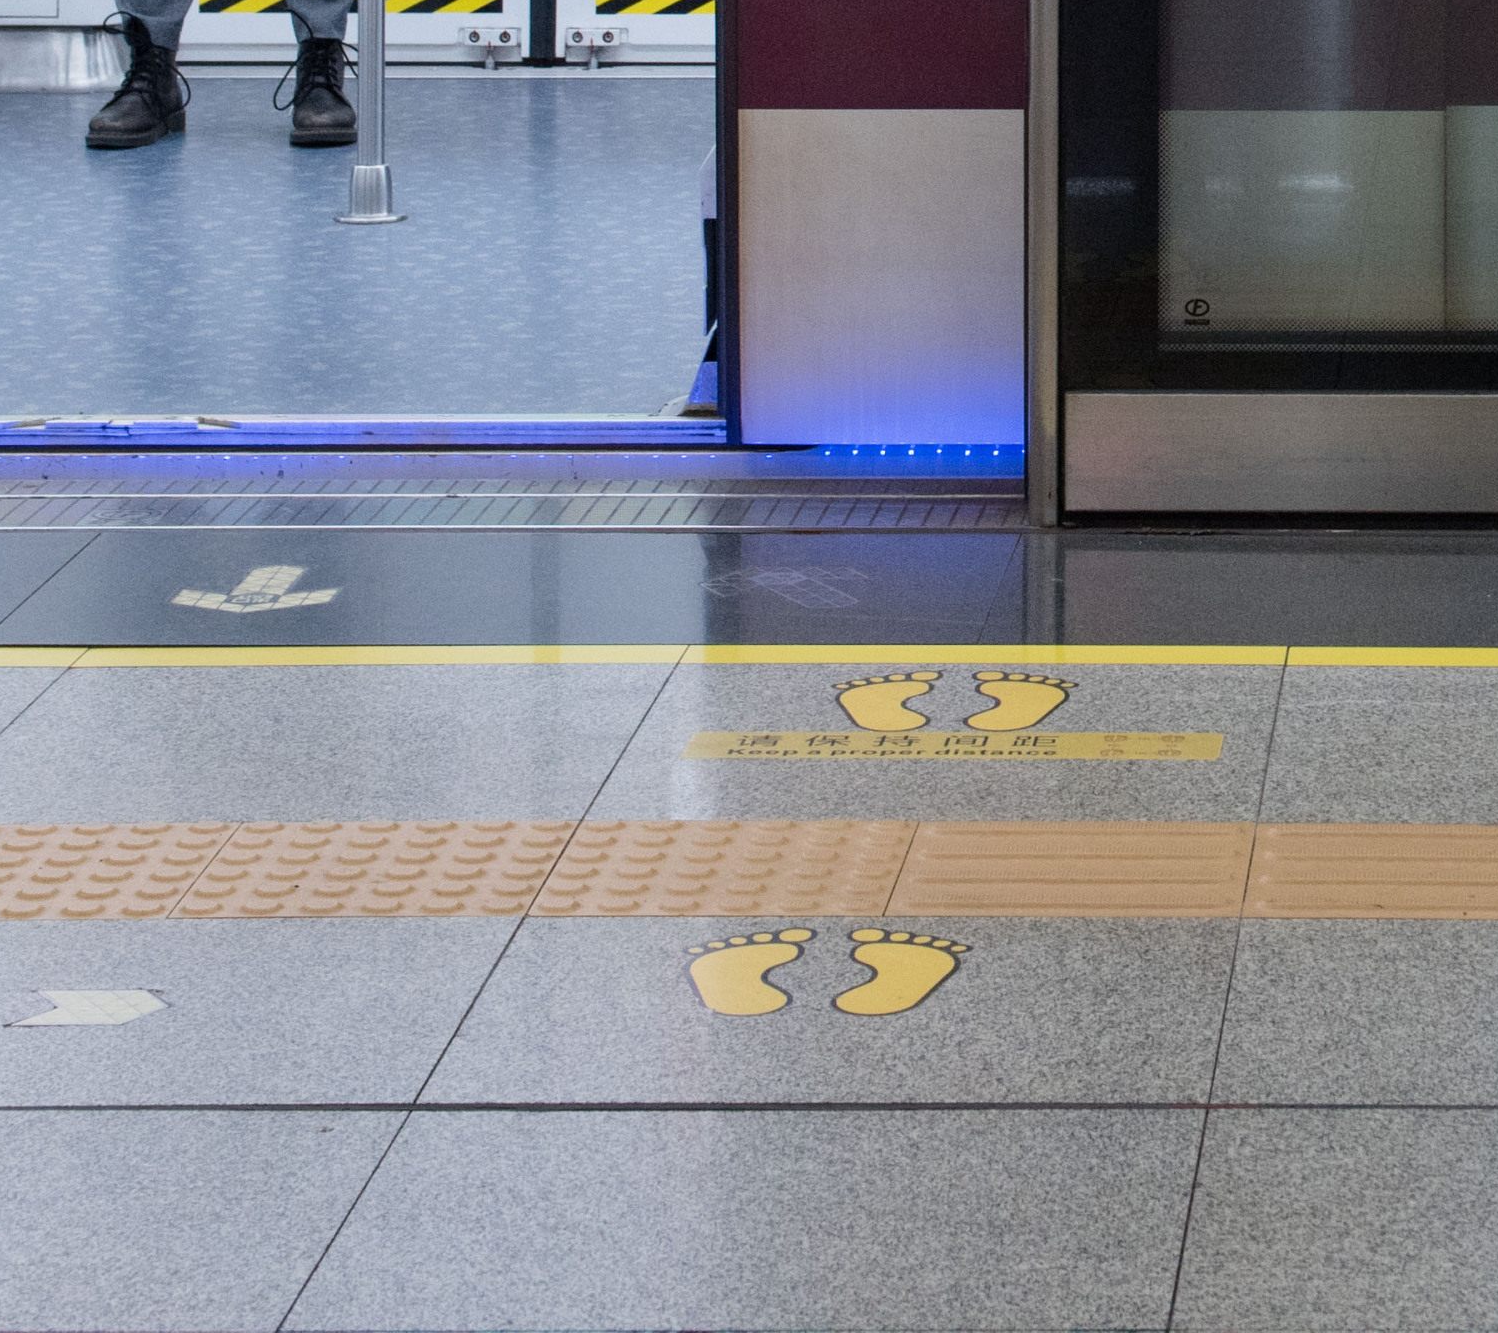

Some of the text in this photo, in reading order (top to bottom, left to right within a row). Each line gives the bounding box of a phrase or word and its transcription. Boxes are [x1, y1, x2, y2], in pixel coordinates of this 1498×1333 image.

[738, 734, 1059, 748] 请保持间距
[726, 748, 799, 757] Keep
[829, 749, 925, 757] proper
[934, 748, 1058, 756] distance
